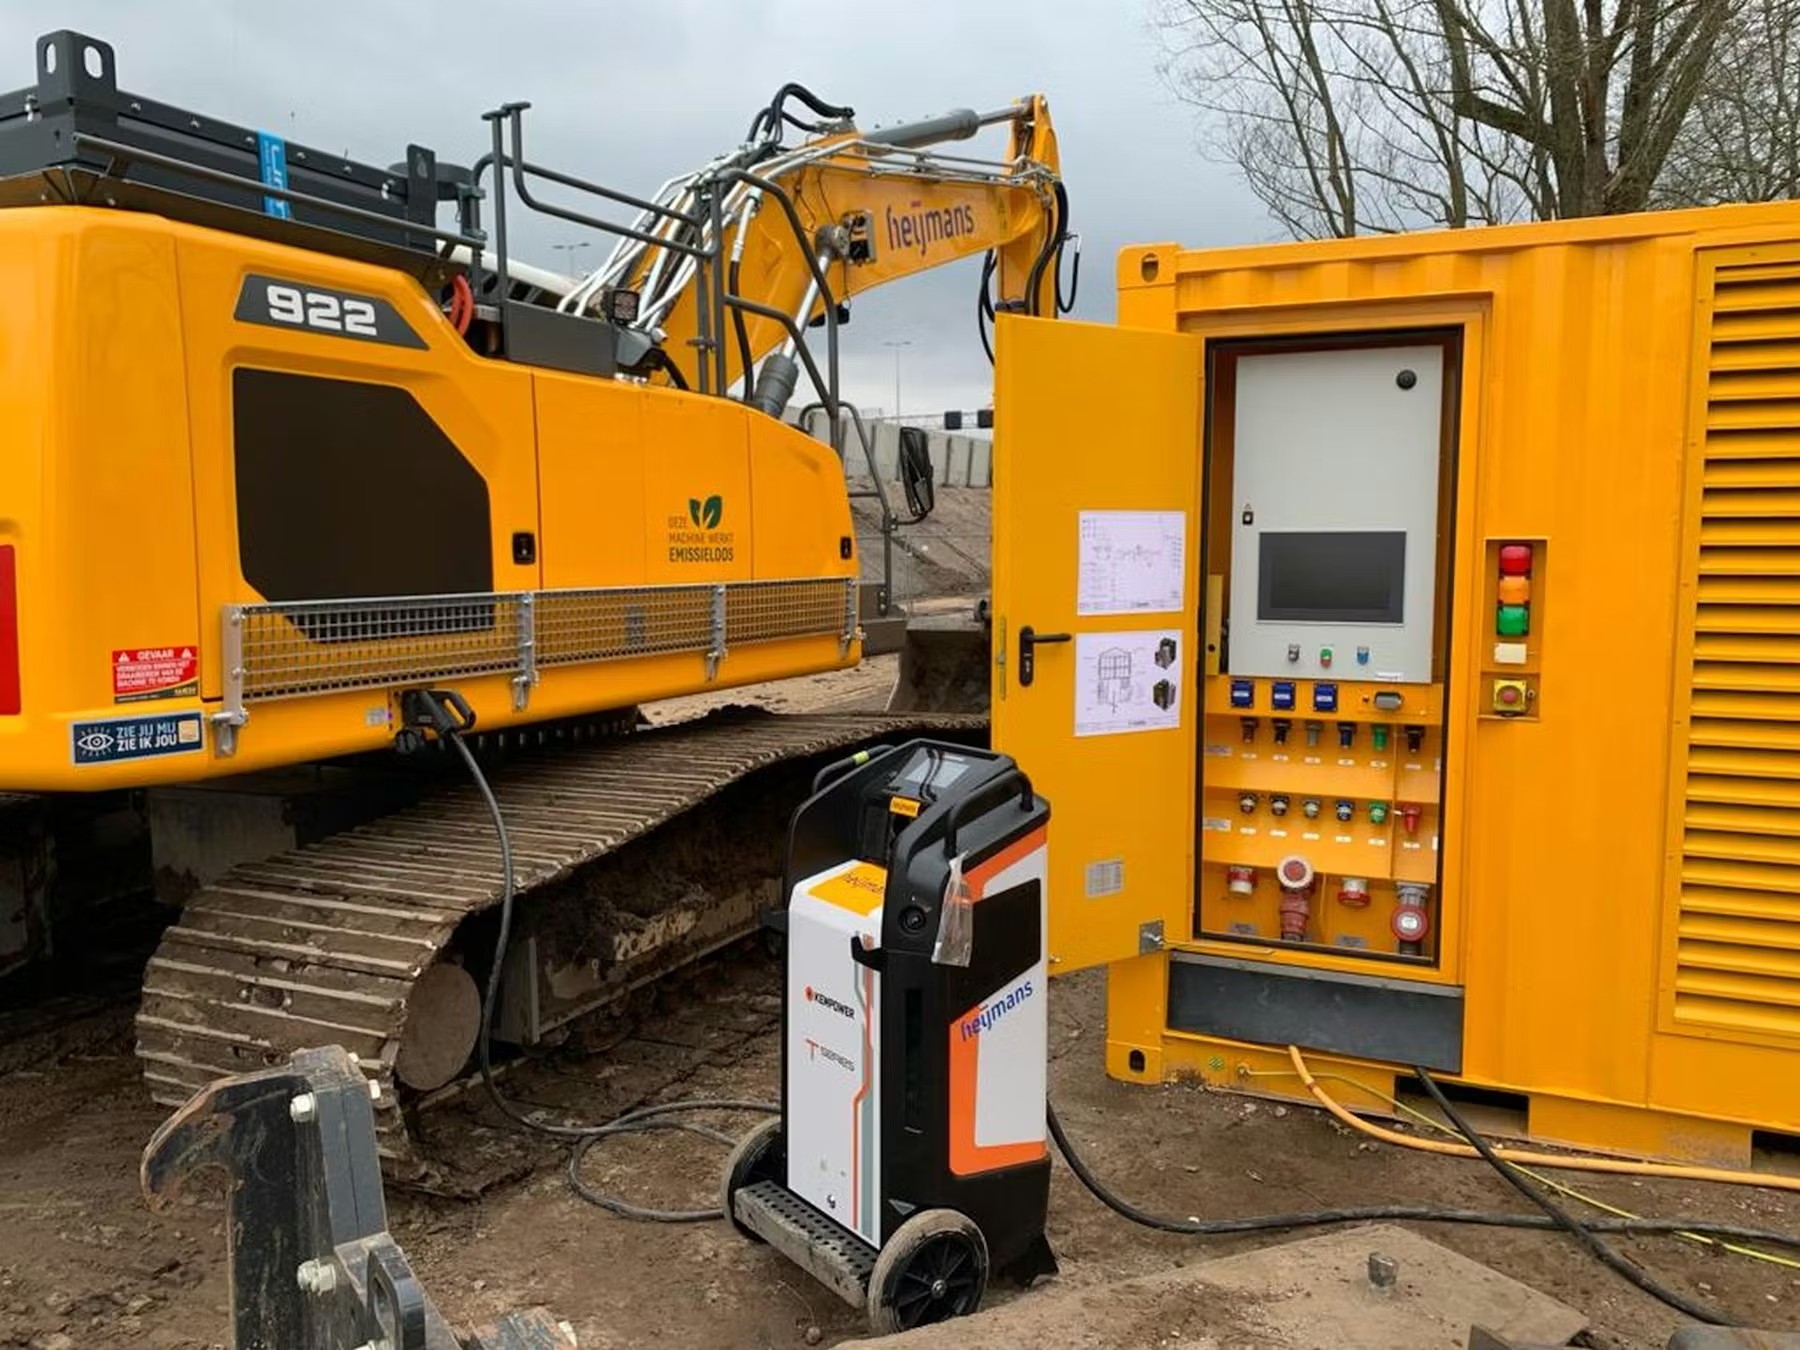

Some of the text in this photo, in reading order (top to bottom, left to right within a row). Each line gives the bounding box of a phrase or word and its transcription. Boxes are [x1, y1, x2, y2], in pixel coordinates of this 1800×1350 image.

[887, 199, 975, 257] heijmans
[266, 285, 378, 336] 922
[669, 532, 705, 545] MACHINE
[669, 546, 734, 563] EMISSIELOOS
[137, 649, 175, 661] GEVAAR
[116, 721, 177, 739] ZIE JIJ MIJ
[117, 734, 177, 752] ZIE IK JOU
[814, 991, 856, 1021] KEMPOWER
[961, 980, 1034, 1042] heijmans
